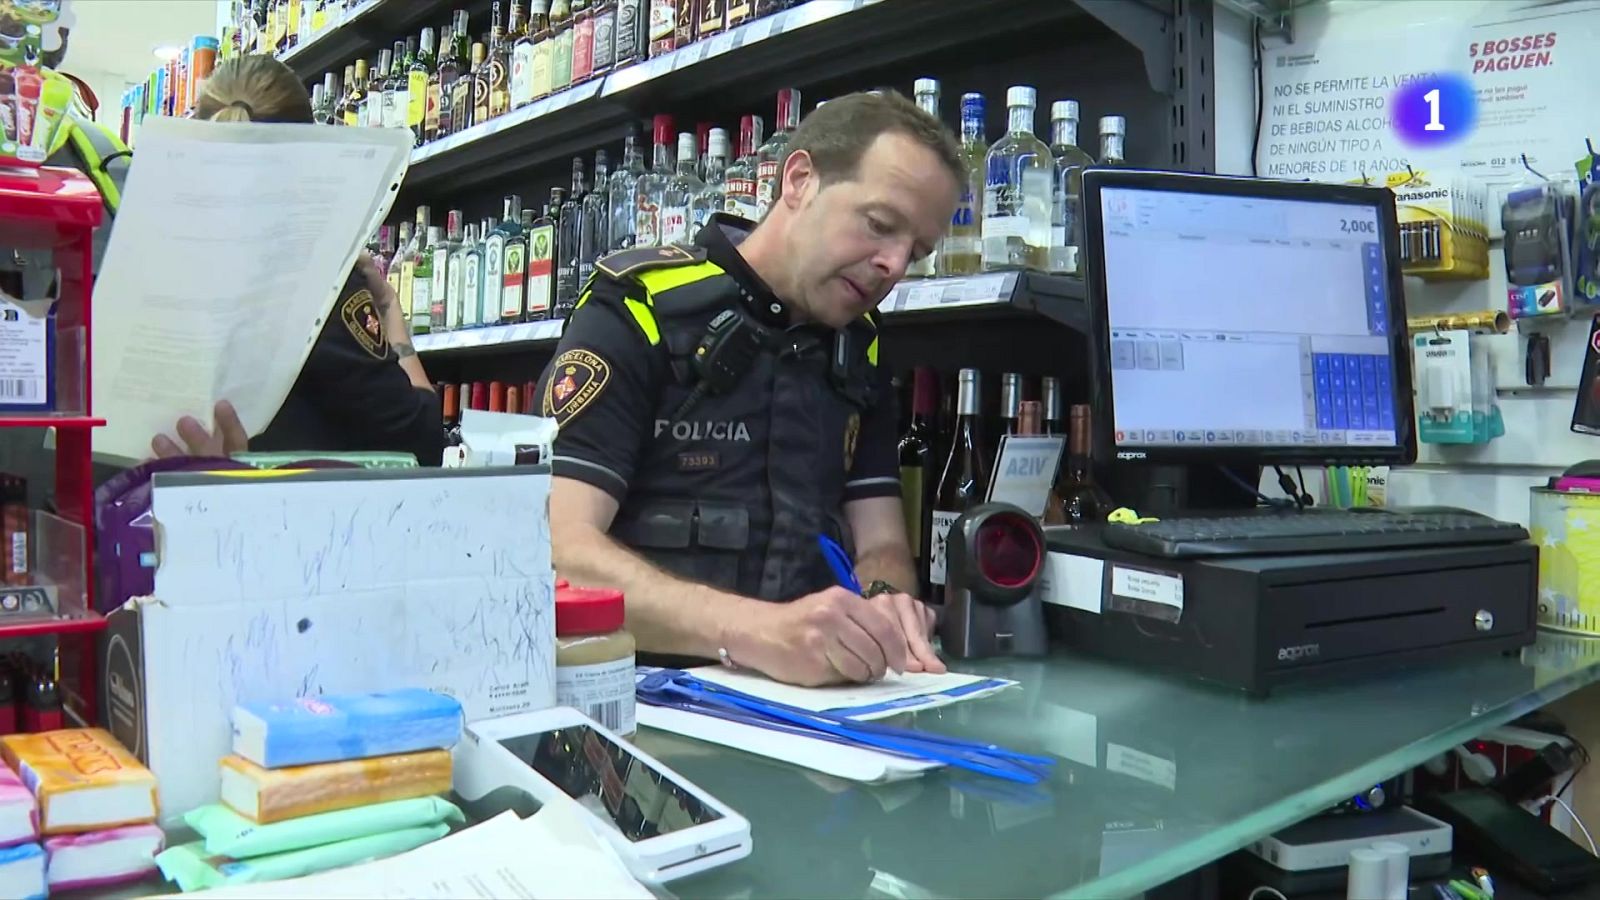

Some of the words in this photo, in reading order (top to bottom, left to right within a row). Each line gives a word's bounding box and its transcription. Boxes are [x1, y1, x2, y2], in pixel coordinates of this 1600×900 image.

[1482, 32, 1557, 56] BOSSES
[1472, 51, 1553, 74] PAGUEN.
[1274, 86, 1292, 97] NO
[1294, 82, 1311, 95] SE
[1314, 77, 1369, 93] PERMITE
[1372, 76, 1389, 88] LA
[1392, 72, 1440, 88] VENTA
[1272, 105, 1285, 117] NI
[1288, 103, 1301, 115] EL
[1304, 97, 1385, 114] SUMINISTRO
[1271, 124, 1286, 136] DE
[1290, 119, 1343, 135] BEBIDAS
[1270, 144, 1285, 156] DE
[1287, 138, 1337, 154] NINGÚN
[1340, 138, 1370, 152] TIPO
[1372, 139, 1382, 151] A
[1268, 160, 1326, 175] MENORES
[1329, 159, 1347, 172] DE
[1352, 159, 1366, 172] 18
[1369, 156, 1408, 172] AÑOS
[1396, 188, 1449, 202] anasonic
[1340, 219, 1376, 234] 2,00€
